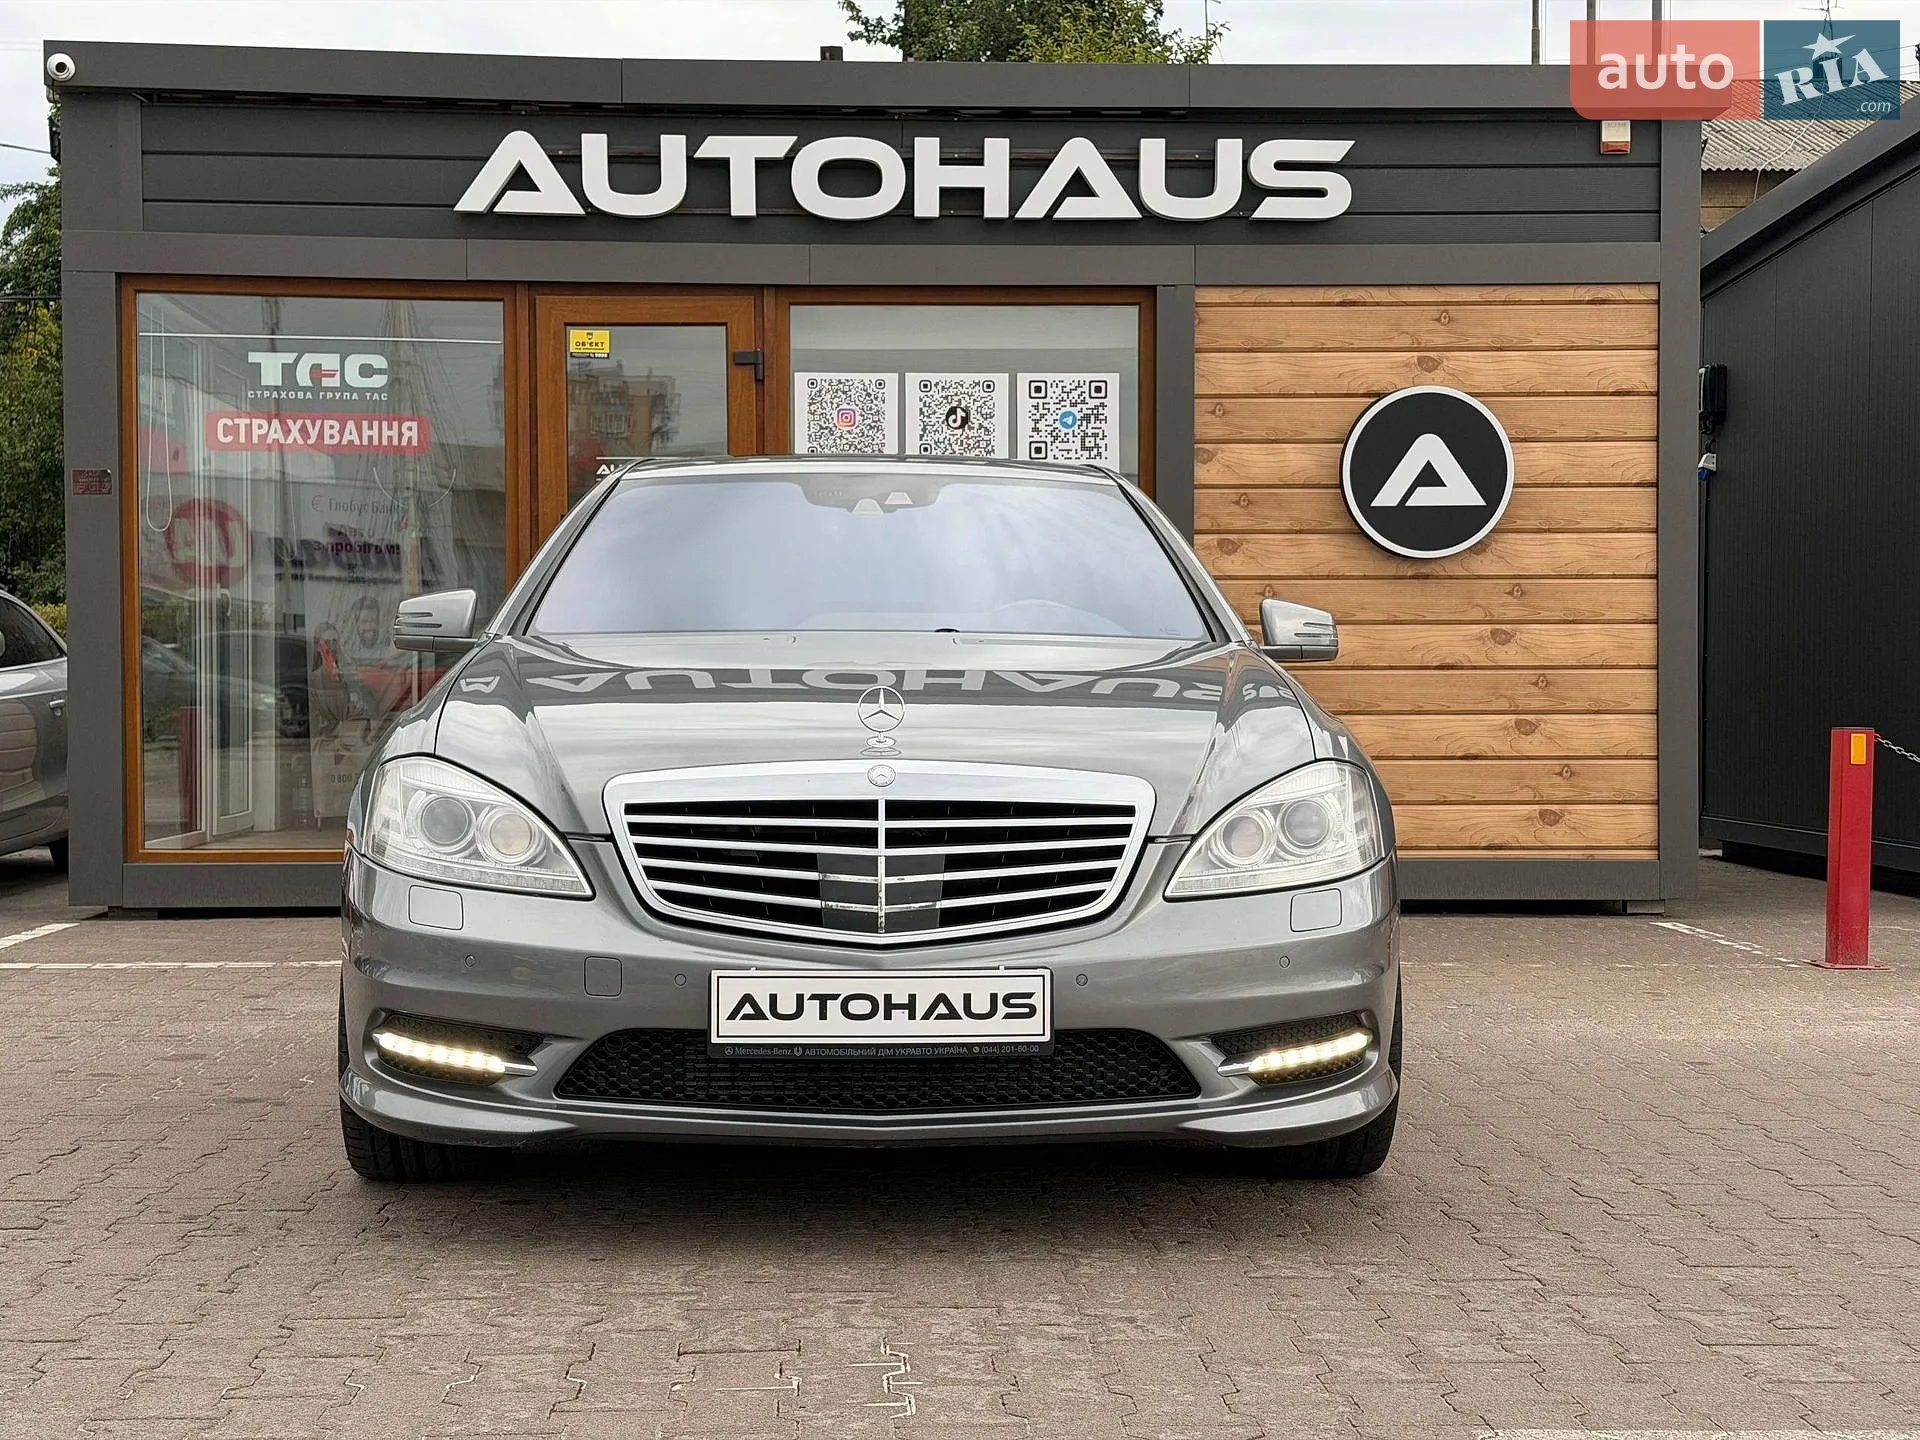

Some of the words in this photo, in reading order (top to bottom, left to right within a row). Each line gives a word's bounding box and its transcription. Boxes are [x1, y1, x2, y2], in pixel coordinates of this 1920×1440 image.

[453, 129, 1356, 221] AUTOHAUS
[248, 391, 312, 400] СТРАХОВА
[319, 391, 359, 400] ГРУПА
[365, 392, 388, 401] ТАС
[216, 418, 419, 447] СТРАХУВАННЯ
[725, 991, 1038, 1021] AUTOHAUS
[734, 1046, 792, 1056] Mercedes-Benz
[804, 1047, 876, 1057] АВТОМОБІЛЬНИЙ
[878, 1048, 894, 1056] ДІМ
[895, 1047, 932, 1056] УКРАВТО
[933, 1045, 968, 1055] УКРАЇНА
[981, 1046, 1000, 1055] (044)
